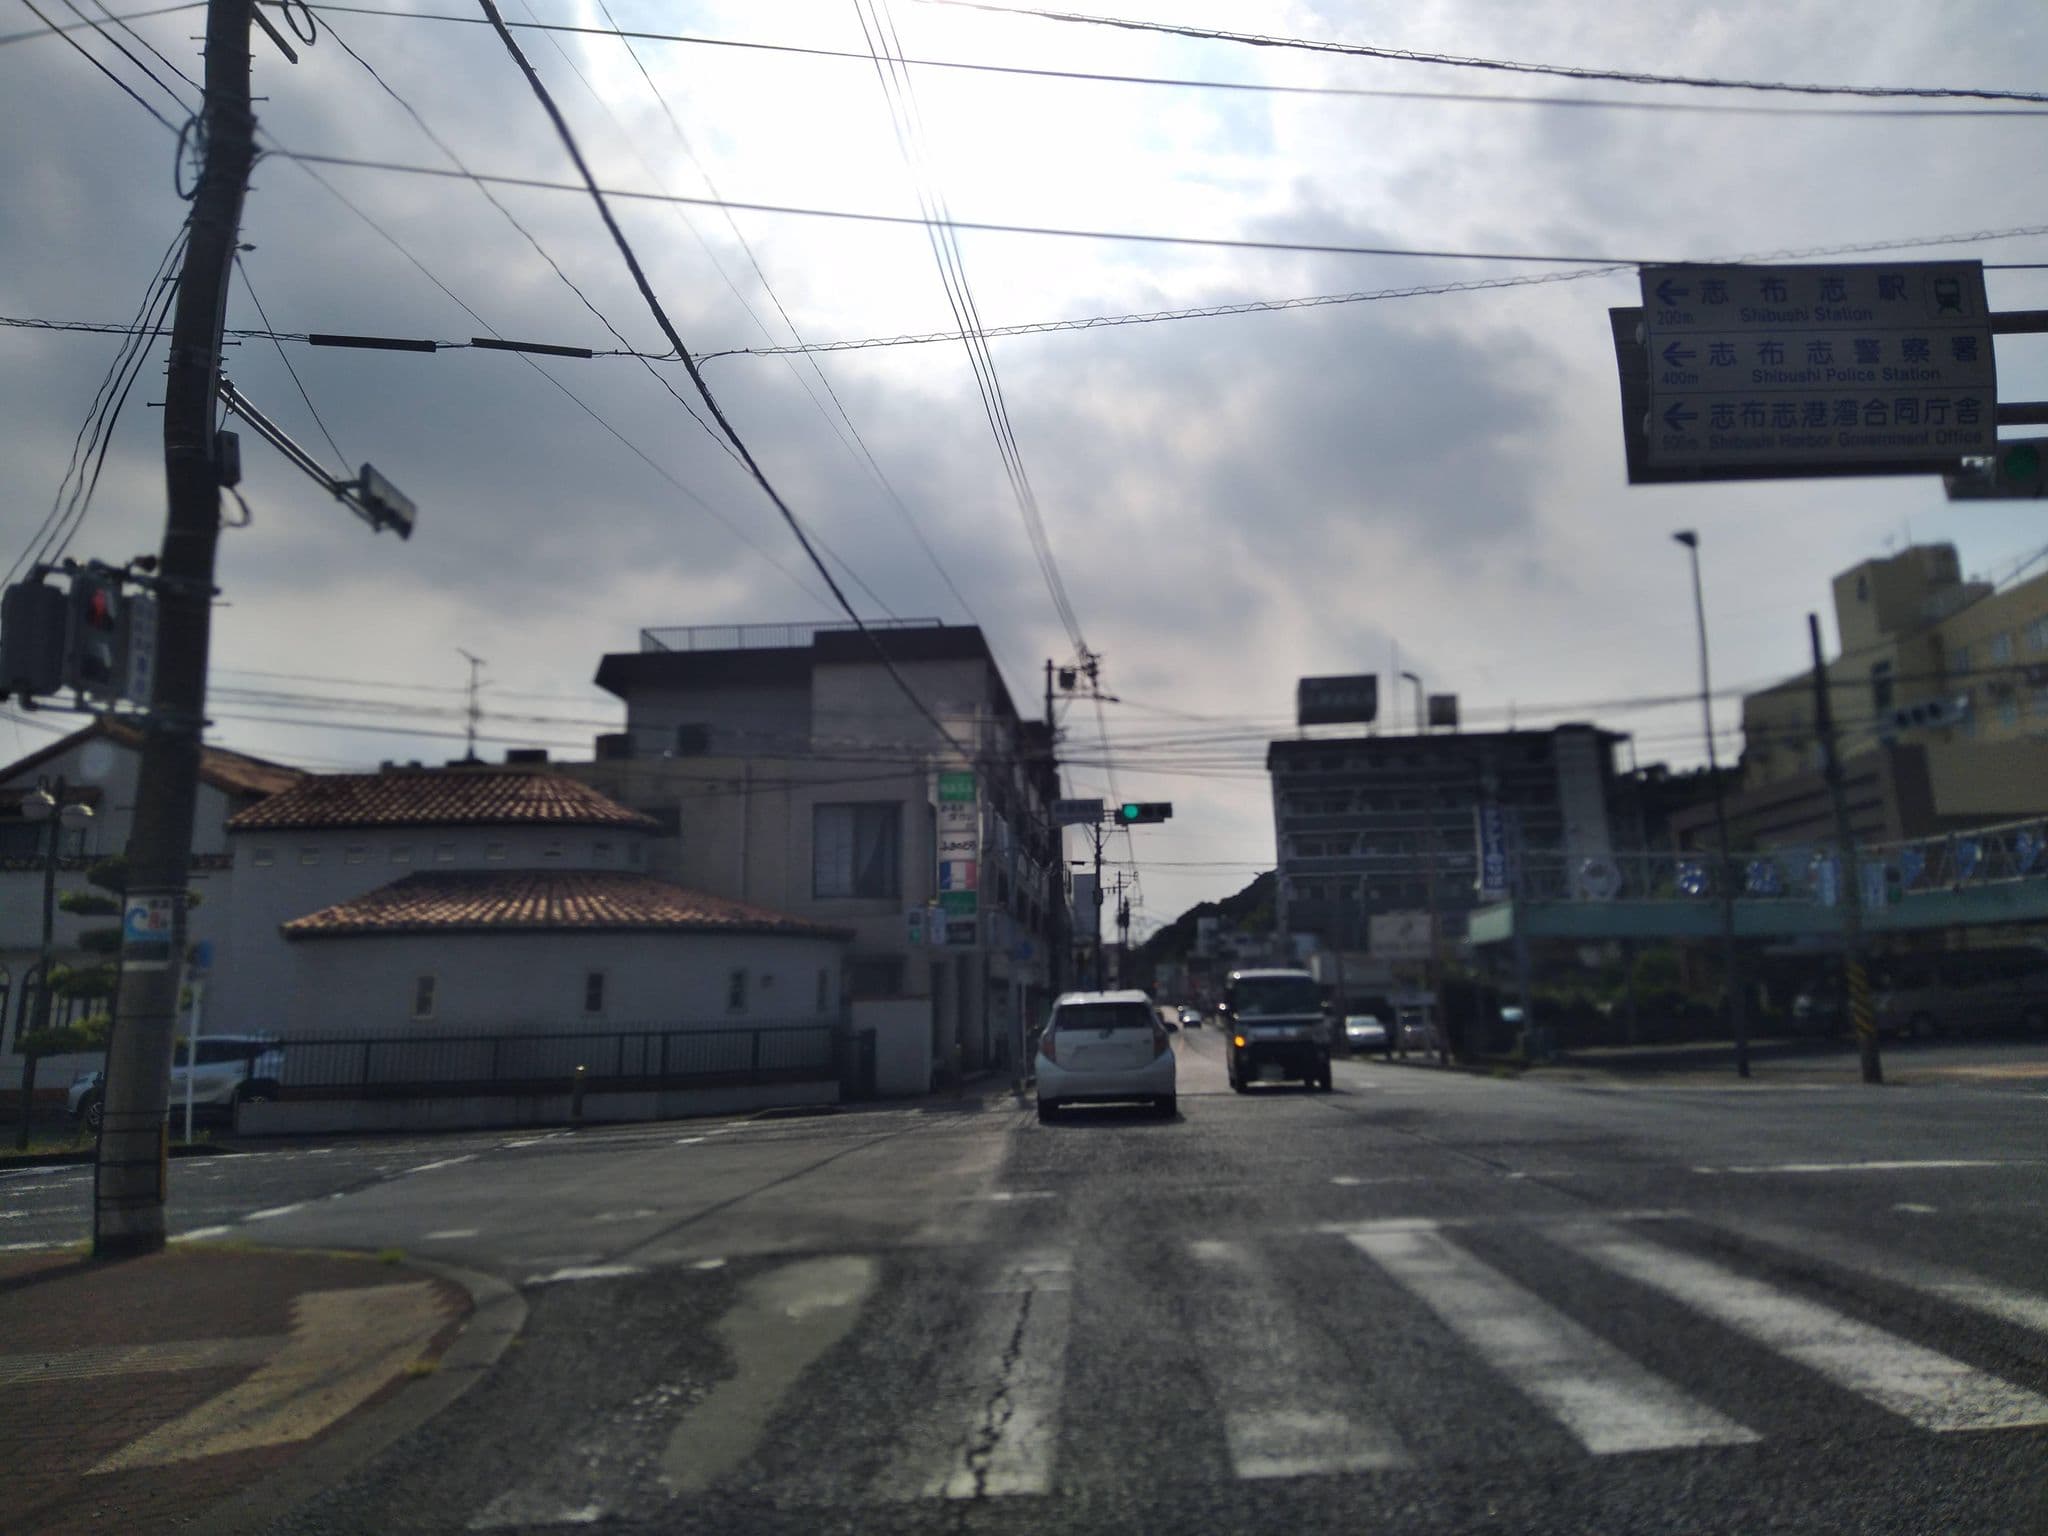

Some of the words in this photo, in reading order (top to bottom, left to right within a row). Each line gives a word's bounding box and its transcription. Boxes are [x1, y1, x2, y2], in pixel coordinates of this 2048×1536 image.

[1699, 273, 1909, 304] 志布志駅
[1657, 310, 1694, 326] 200m
[1740, 307, 1809, 323] Shibushi
[1814, 306, 1873, 321] Station
[1708, 336, 1980, 368] 志布志警察署
[1662, 369, 1698, 385] 400m
[1751, 368, 1821, 384] Shibushi
[1827, 367, 1875, 382] Police
[1881, 366, 1941, 382] Station
[1709, 397, 1982, 430] 志布志港湾合同庁舎
[1936, 427, 1982, 445] Office
